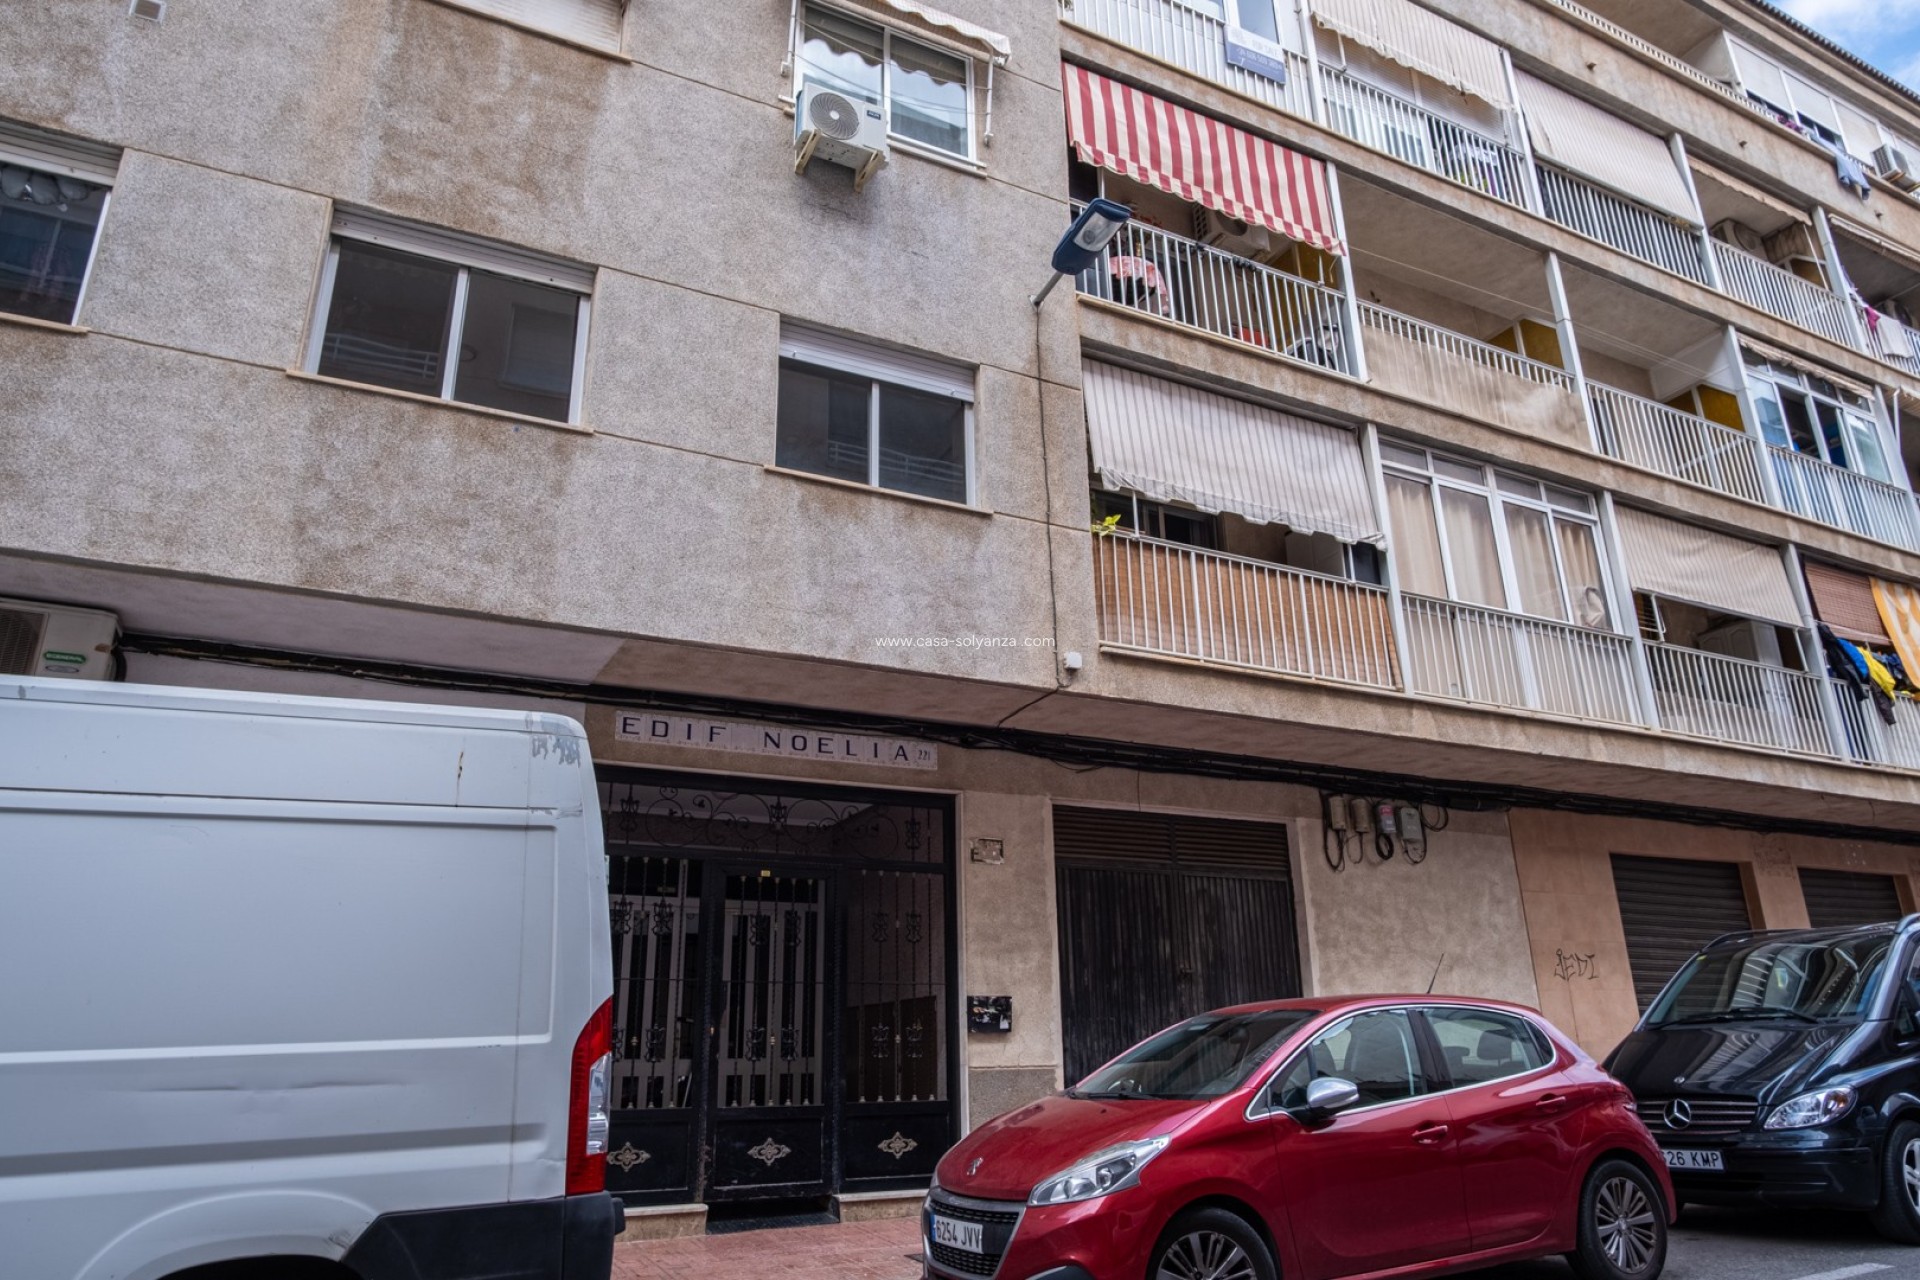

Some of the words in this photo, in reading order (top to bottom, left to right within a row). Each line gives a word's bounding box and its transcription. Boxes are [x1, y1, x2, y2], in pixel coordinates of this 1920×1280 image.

[621, 716, 726, 743] EDIF
[763, 731, 909, 762] NOELIA
[1662, 1150, 1686, 1166] 26
[1690, 1151, 1719, 1168] KMP
[936, 1220, 958, 1245] 6254
[961, 1225, 981, 1249] JVV
